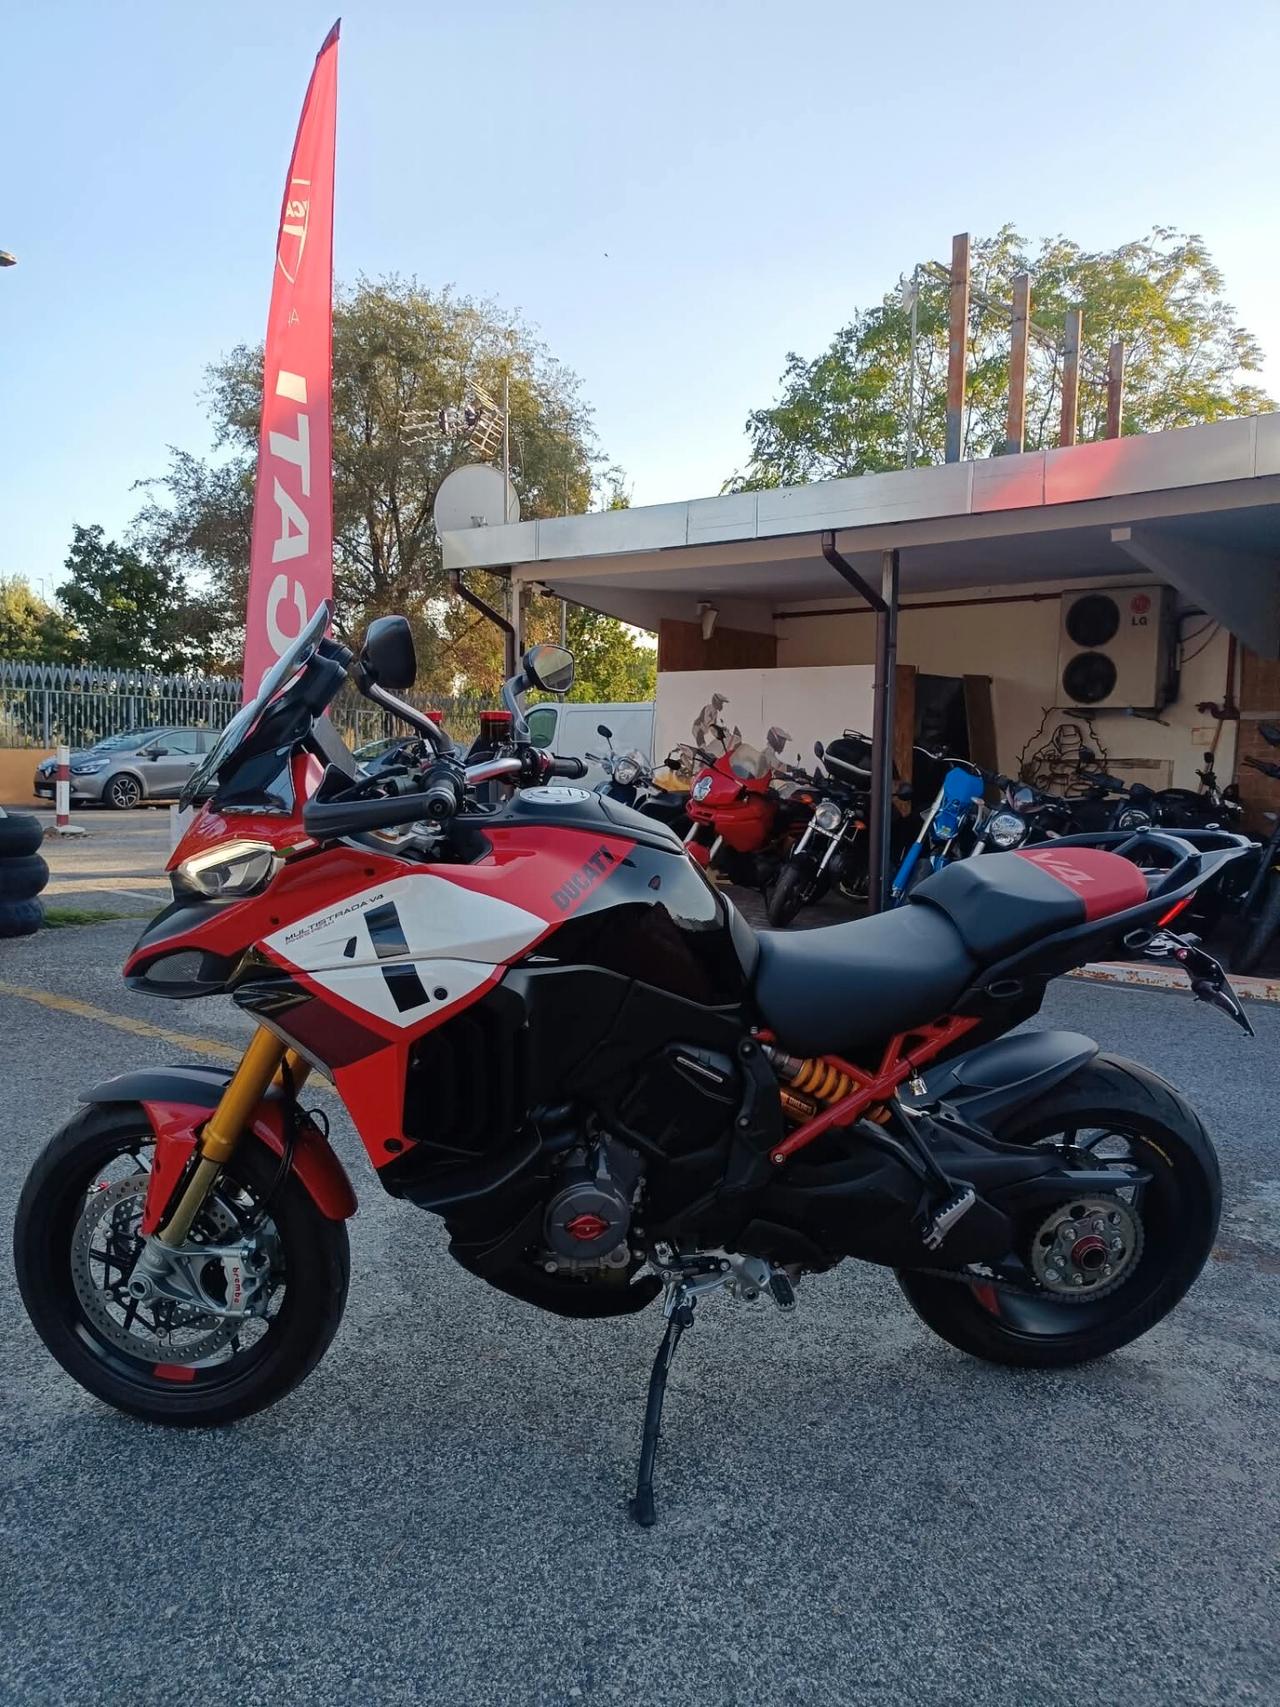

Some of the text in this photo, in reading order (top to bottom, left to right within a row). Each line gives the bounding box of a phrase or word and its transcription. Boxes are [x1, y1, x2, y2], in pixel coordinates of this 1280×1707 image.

[1131, 616, 1148, 626] LG
[550, 844, 616, 912] DUCATI
[1029, 852, 1096, 885] V4
[284, 892, 385, 942] MULTISTRADA V4
[231, 1266, 242, 1304] brembo
